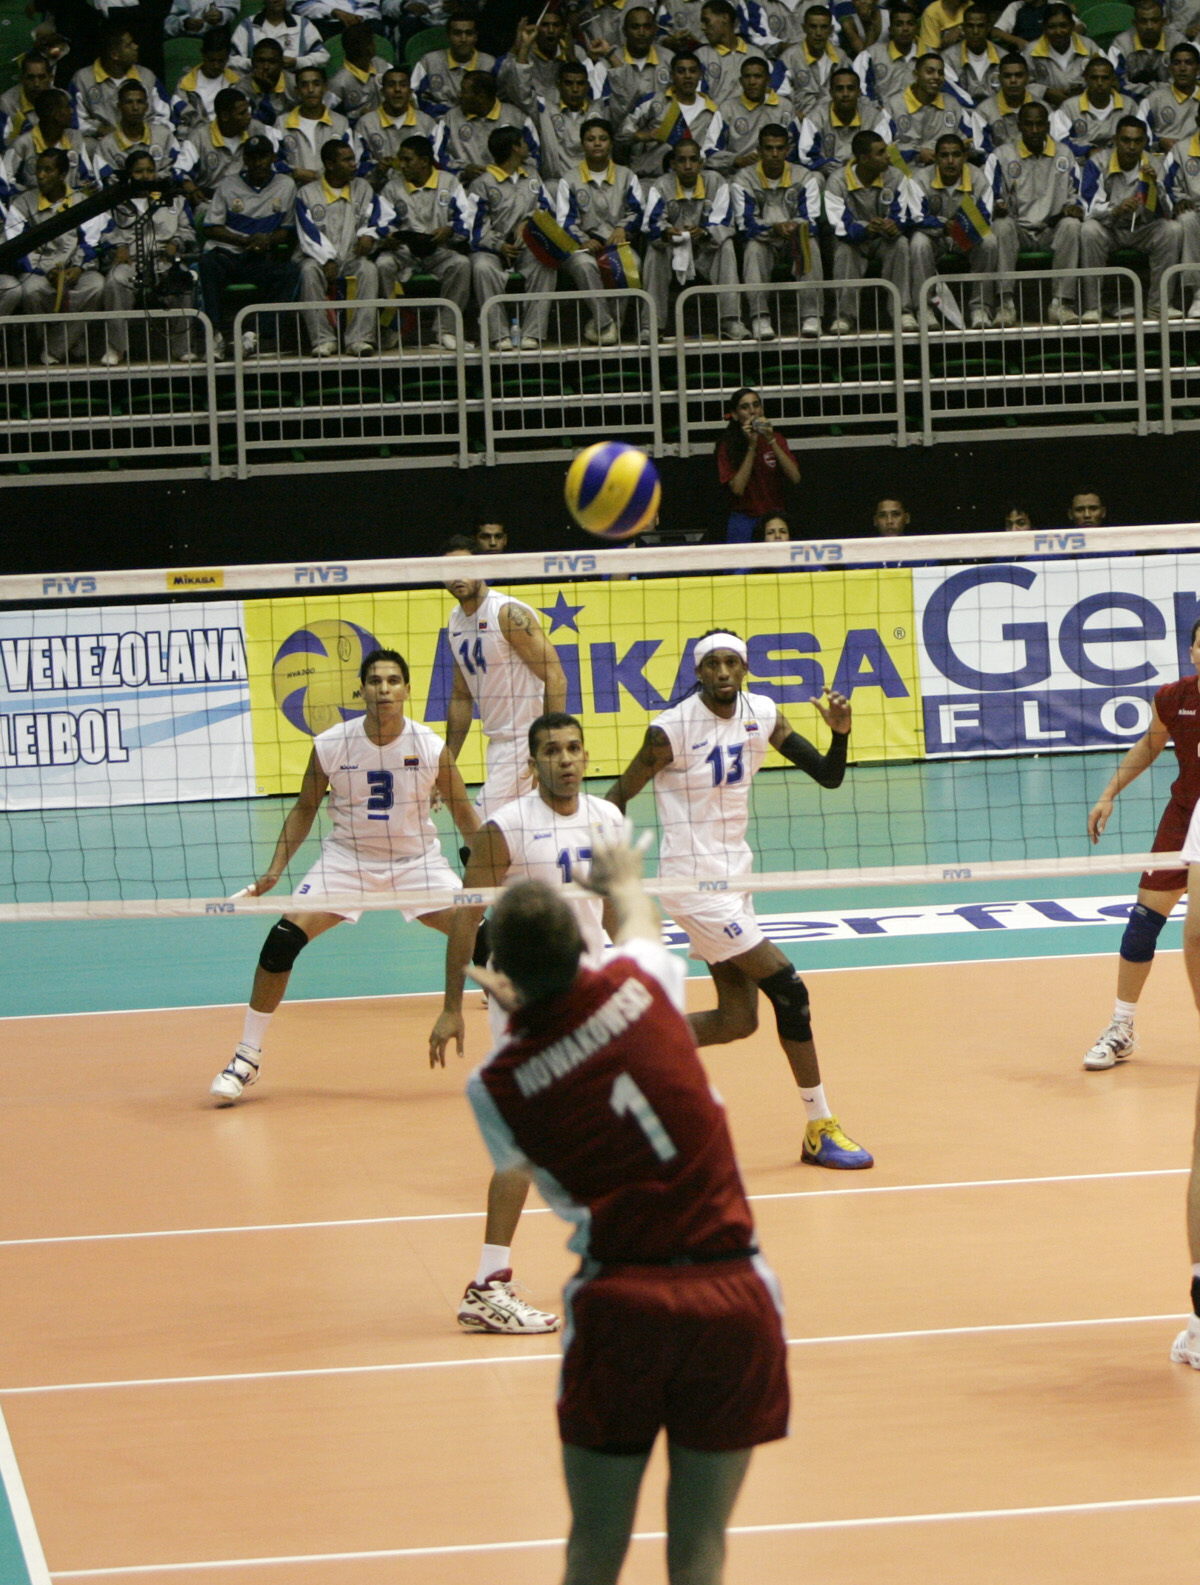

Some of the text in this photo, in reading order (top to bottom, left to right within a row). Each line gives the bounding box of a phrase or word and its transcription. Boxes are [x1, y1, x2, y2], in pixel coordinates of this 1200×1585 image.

[791, 544, 843, 562] FIVB
[1034, 533, 1086, 551] FIVB
[295, 566, 349, 584] FIVB
[544, 555, 596, 573] FIVB
[42, 576, 97, 595] FIVB
[0, 627, 248, 692] VENEZOLANA
[459, 637, 487, 675] 14
[0, 708, 129, 768] LEIBOL
[705, 743, 745, 788] 13
[367, 771, 394, 810] 3
[723, 922, 744, 939] 13
[609, 1070, 679, 1162] 1
